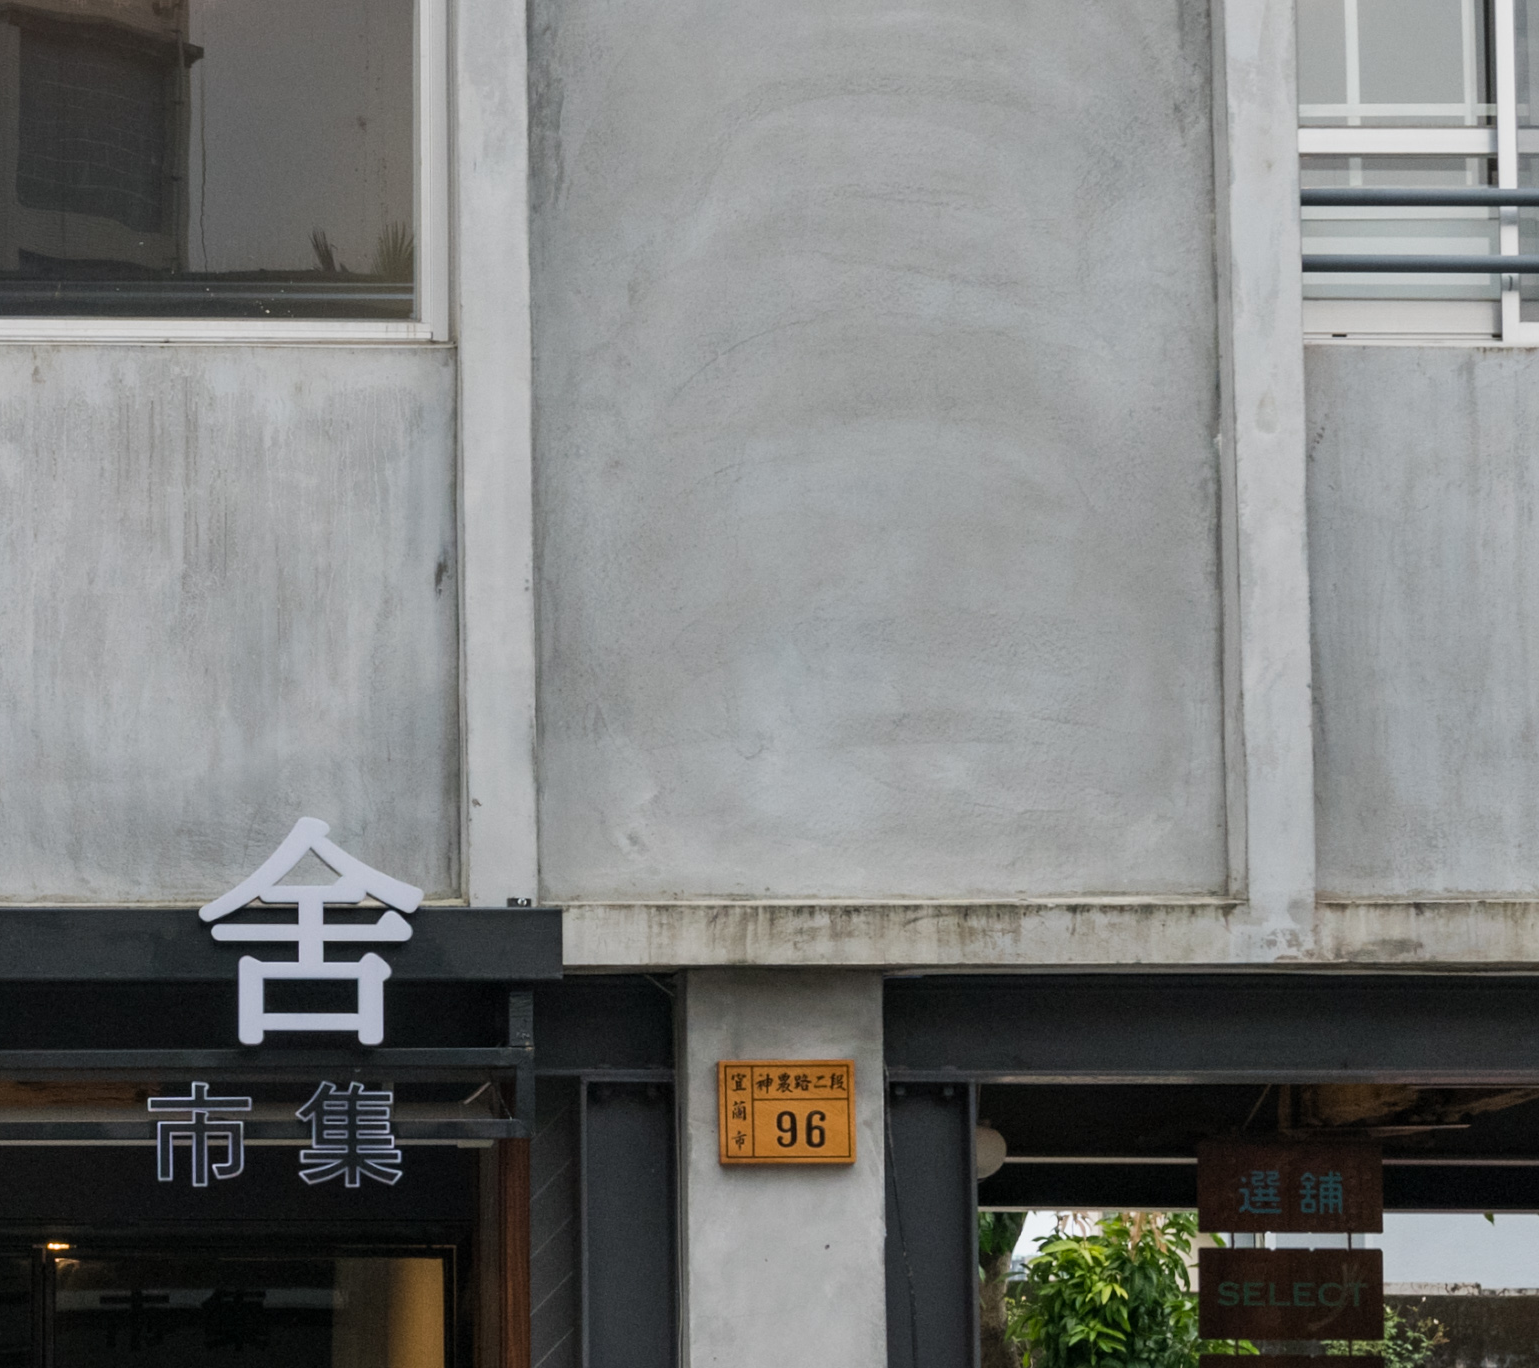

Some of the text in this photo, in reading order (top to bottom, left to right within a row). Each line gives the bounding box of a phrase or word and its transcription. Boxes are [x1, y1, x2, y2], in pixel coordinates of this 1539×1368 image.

[755, 1072, 846, 1095] 神農路二段
[731, 1073, 748, 1151] 宜蘭市
[776, 1110, 826, 1149] 96
[147, 1080, 404, 1189] 市集
[1217, 1281, 1368, 1308] SELECT
